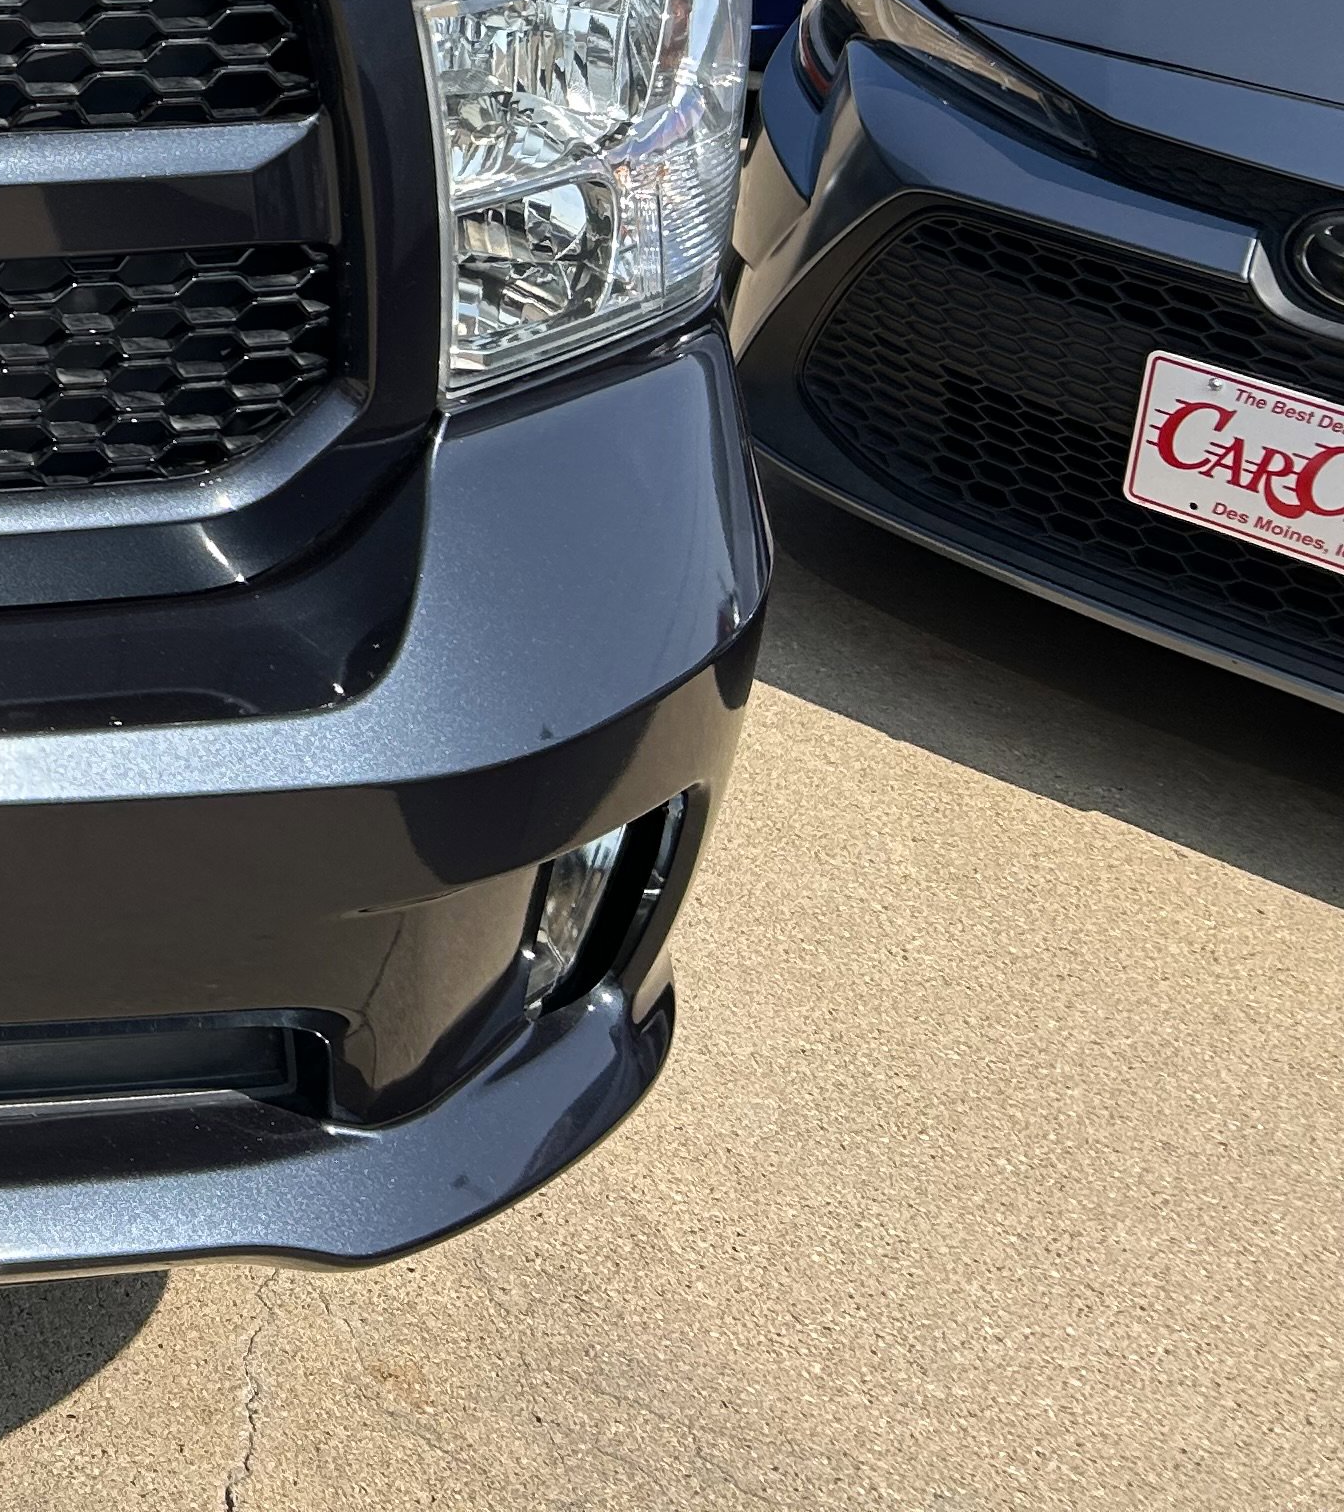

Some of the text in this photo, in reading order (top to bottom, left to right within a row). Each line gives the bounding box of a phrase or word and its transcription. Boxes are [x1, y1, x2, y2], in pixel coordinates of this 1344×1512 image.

[1235, 387, 1344, 435] The Best De
[1211, 501, 1249, 525] Des
[1252, 515, 1329, 555] Moines,
